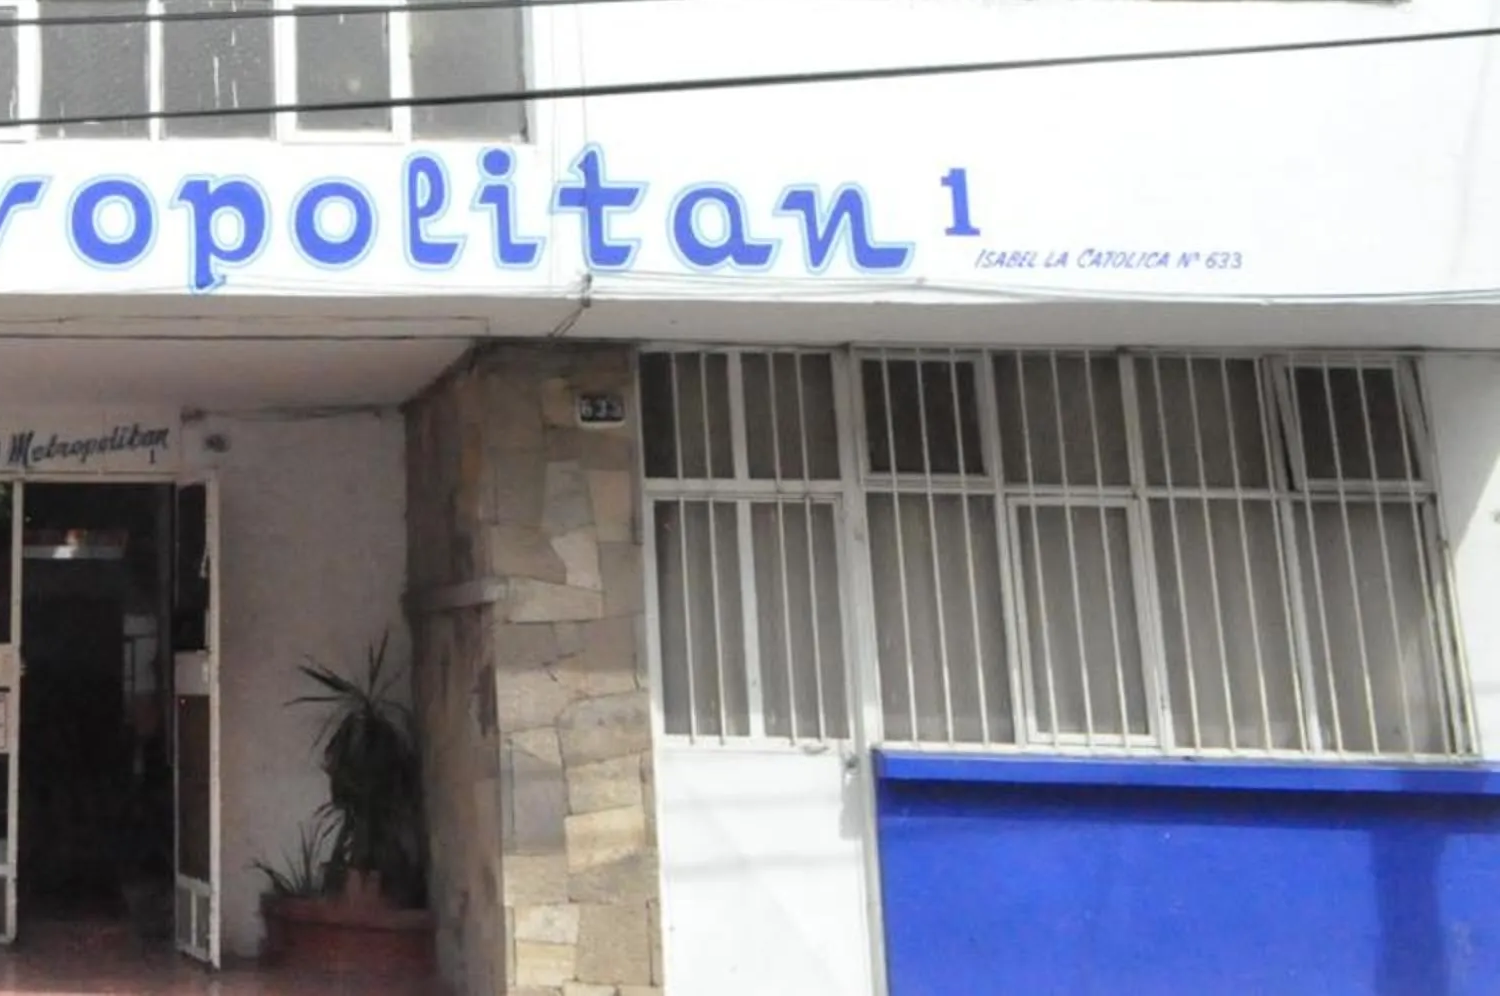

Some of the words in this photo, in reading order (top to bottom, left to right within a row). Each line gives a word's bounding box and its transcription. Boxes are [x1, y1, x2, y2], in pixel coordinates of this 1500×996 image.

[940, 167, 981, 236] 1
[974, 249, 1038, 269] ISABEL
[1044, 251, 1070, 268] LA
[1076, 248, 1171, 269] CATOLICA
[1204, 251, 1243, 269] 633
[8, 423, 169, 468] Metropolitan
